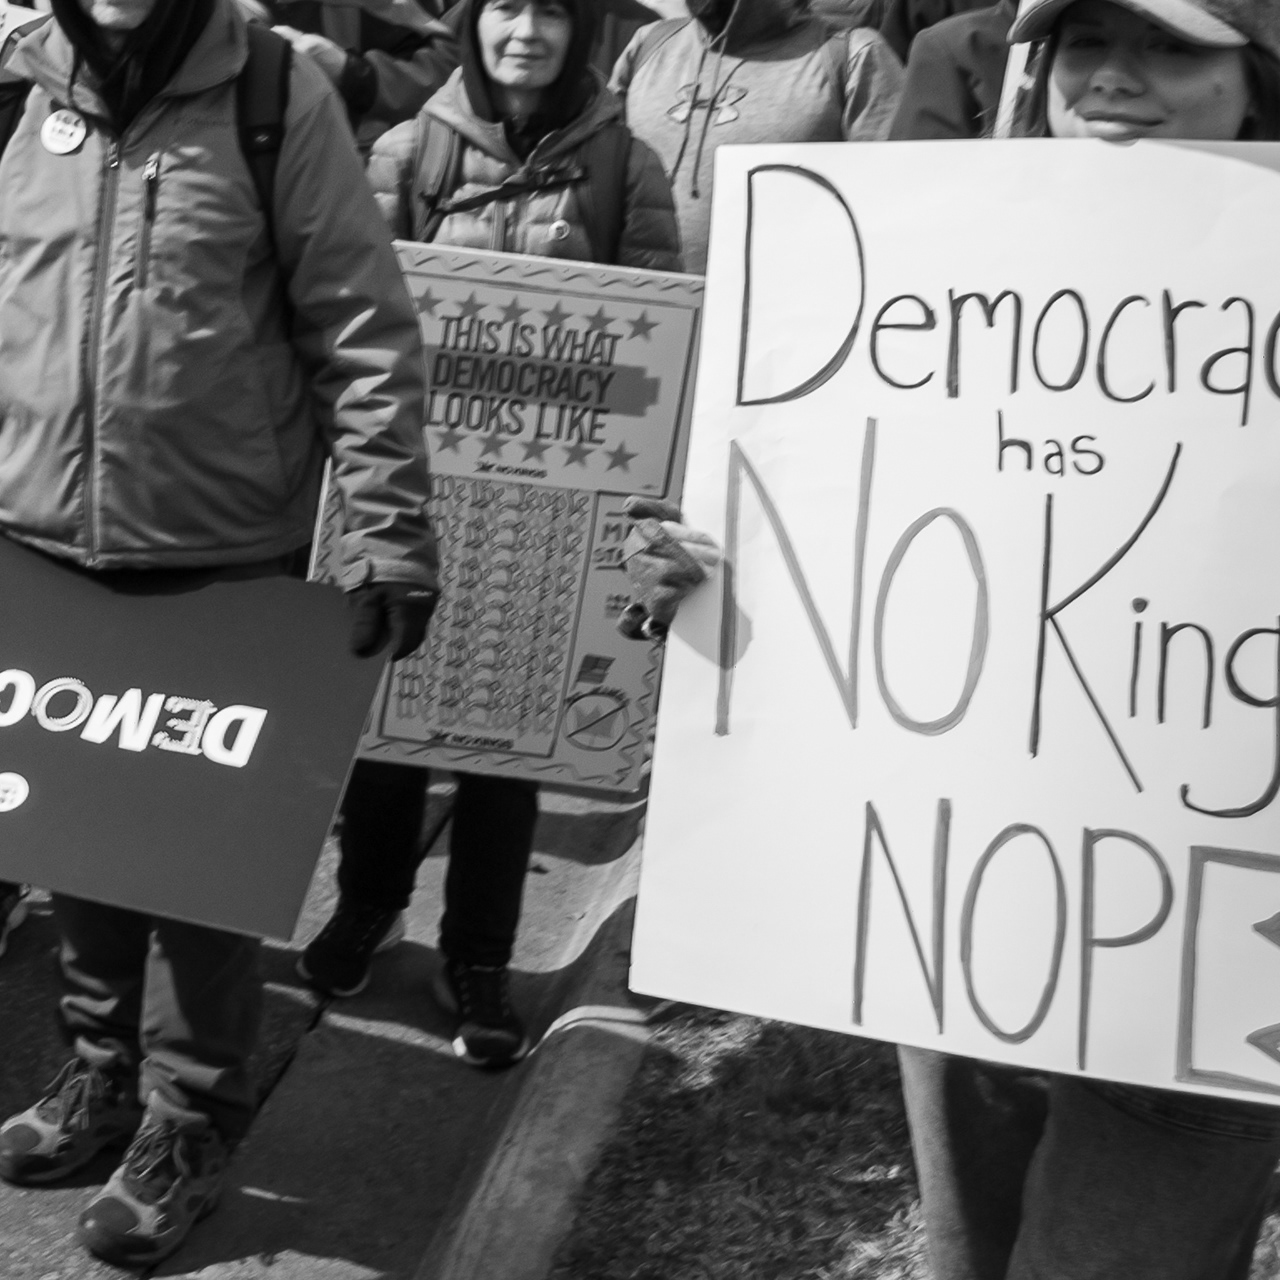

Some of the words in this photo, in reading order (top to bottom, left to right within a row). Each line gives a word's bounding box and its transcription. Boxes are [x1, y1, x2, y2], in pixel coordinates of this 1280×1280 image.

[440, 315, 503, 354] THIS
[507, 322, 538, 357] IS
[542, 325, 624, 367] WHAT
[433, 352, 616, 405] DEMOCRACY
[426, 389, 527, 436] LOOKS
[536, 402, 611, 445] LIKE
[997, 408, 1106, 477] has
[714, 417, 989, 737] NO
